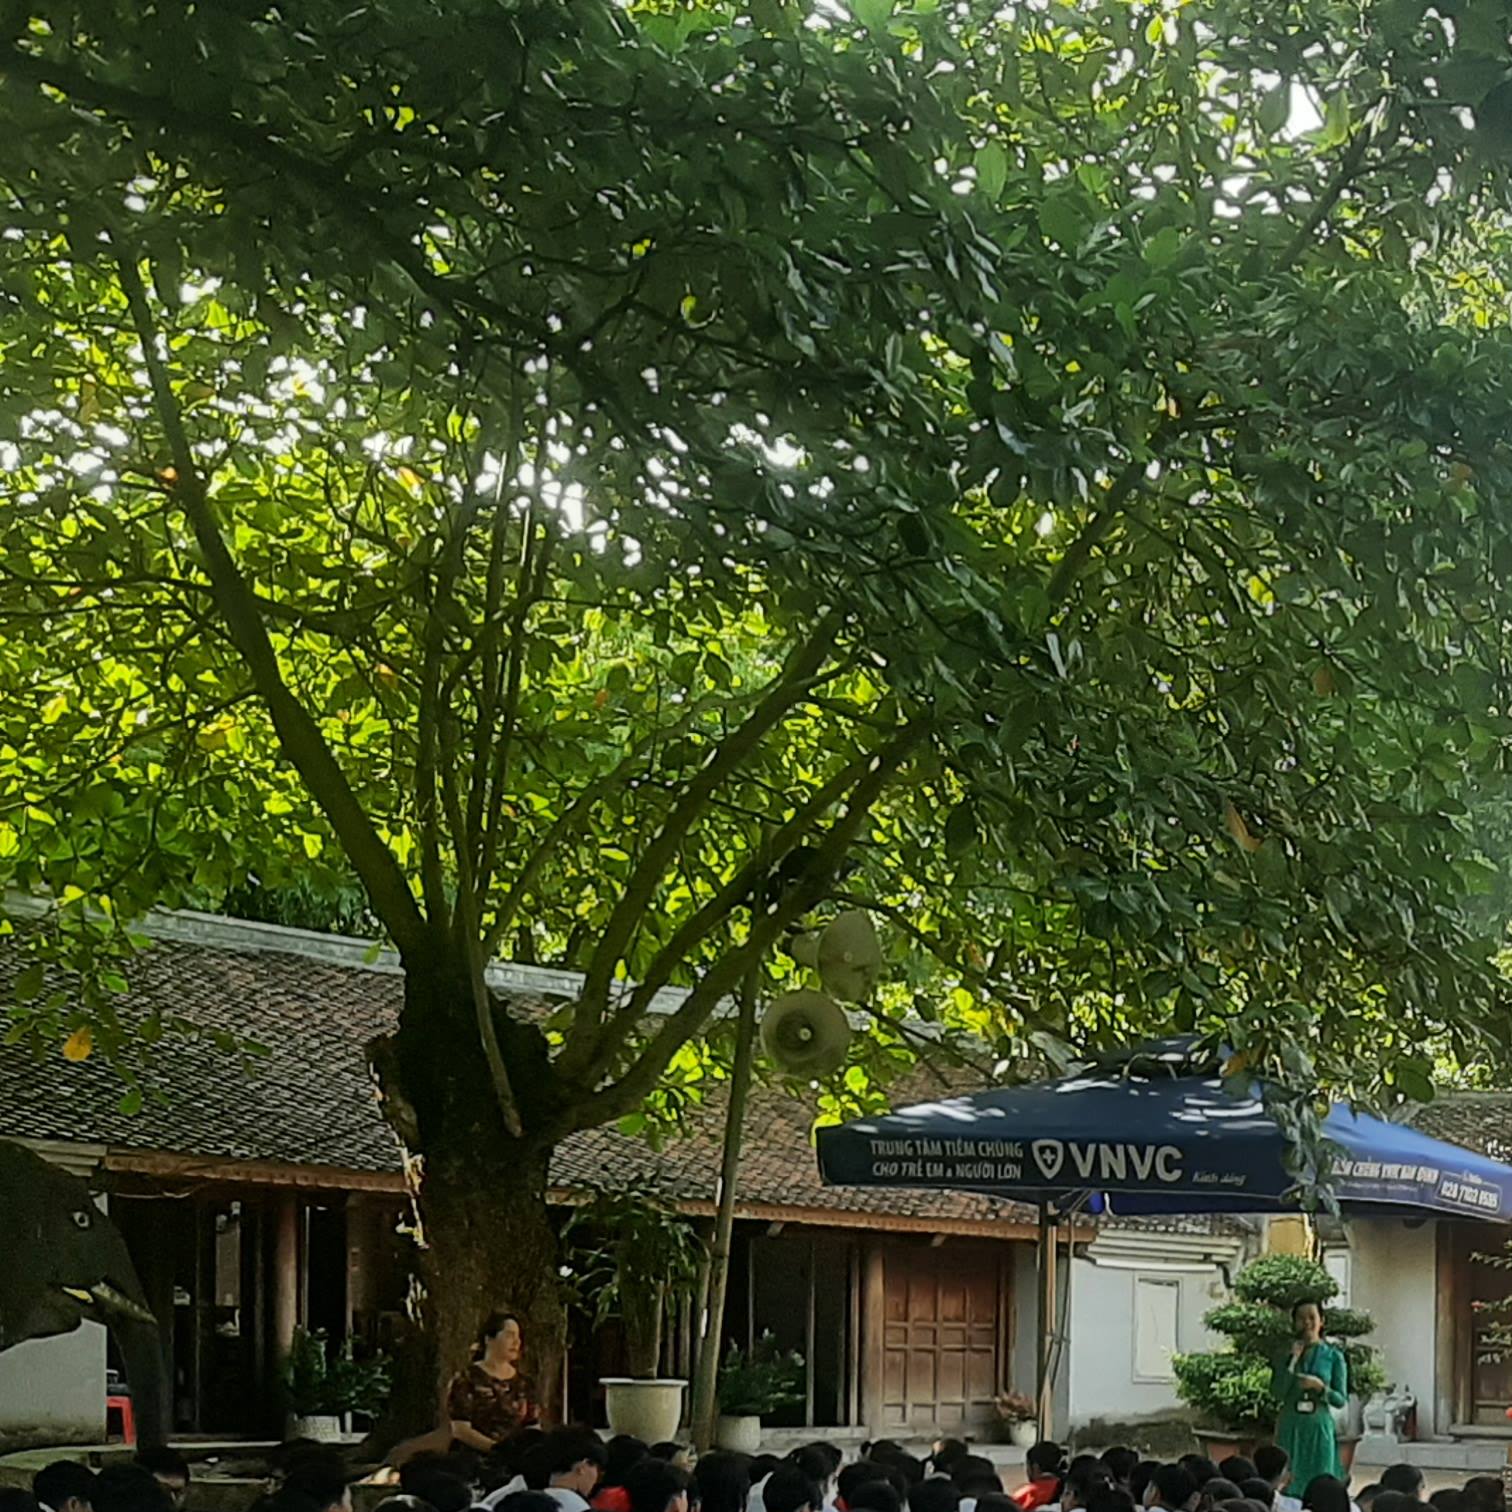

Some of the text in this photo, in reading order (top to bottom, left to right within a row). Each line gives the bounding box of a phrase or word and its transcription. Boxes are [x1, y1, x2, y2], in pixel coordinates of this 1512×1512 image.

[870, 1139, 914, 1156] TRUNG
[914, 1137, 943, 1156] TÂM
[872, 1161, 899, 1177] CHO
[1068, 1142, 1183, 1182] VNVC
